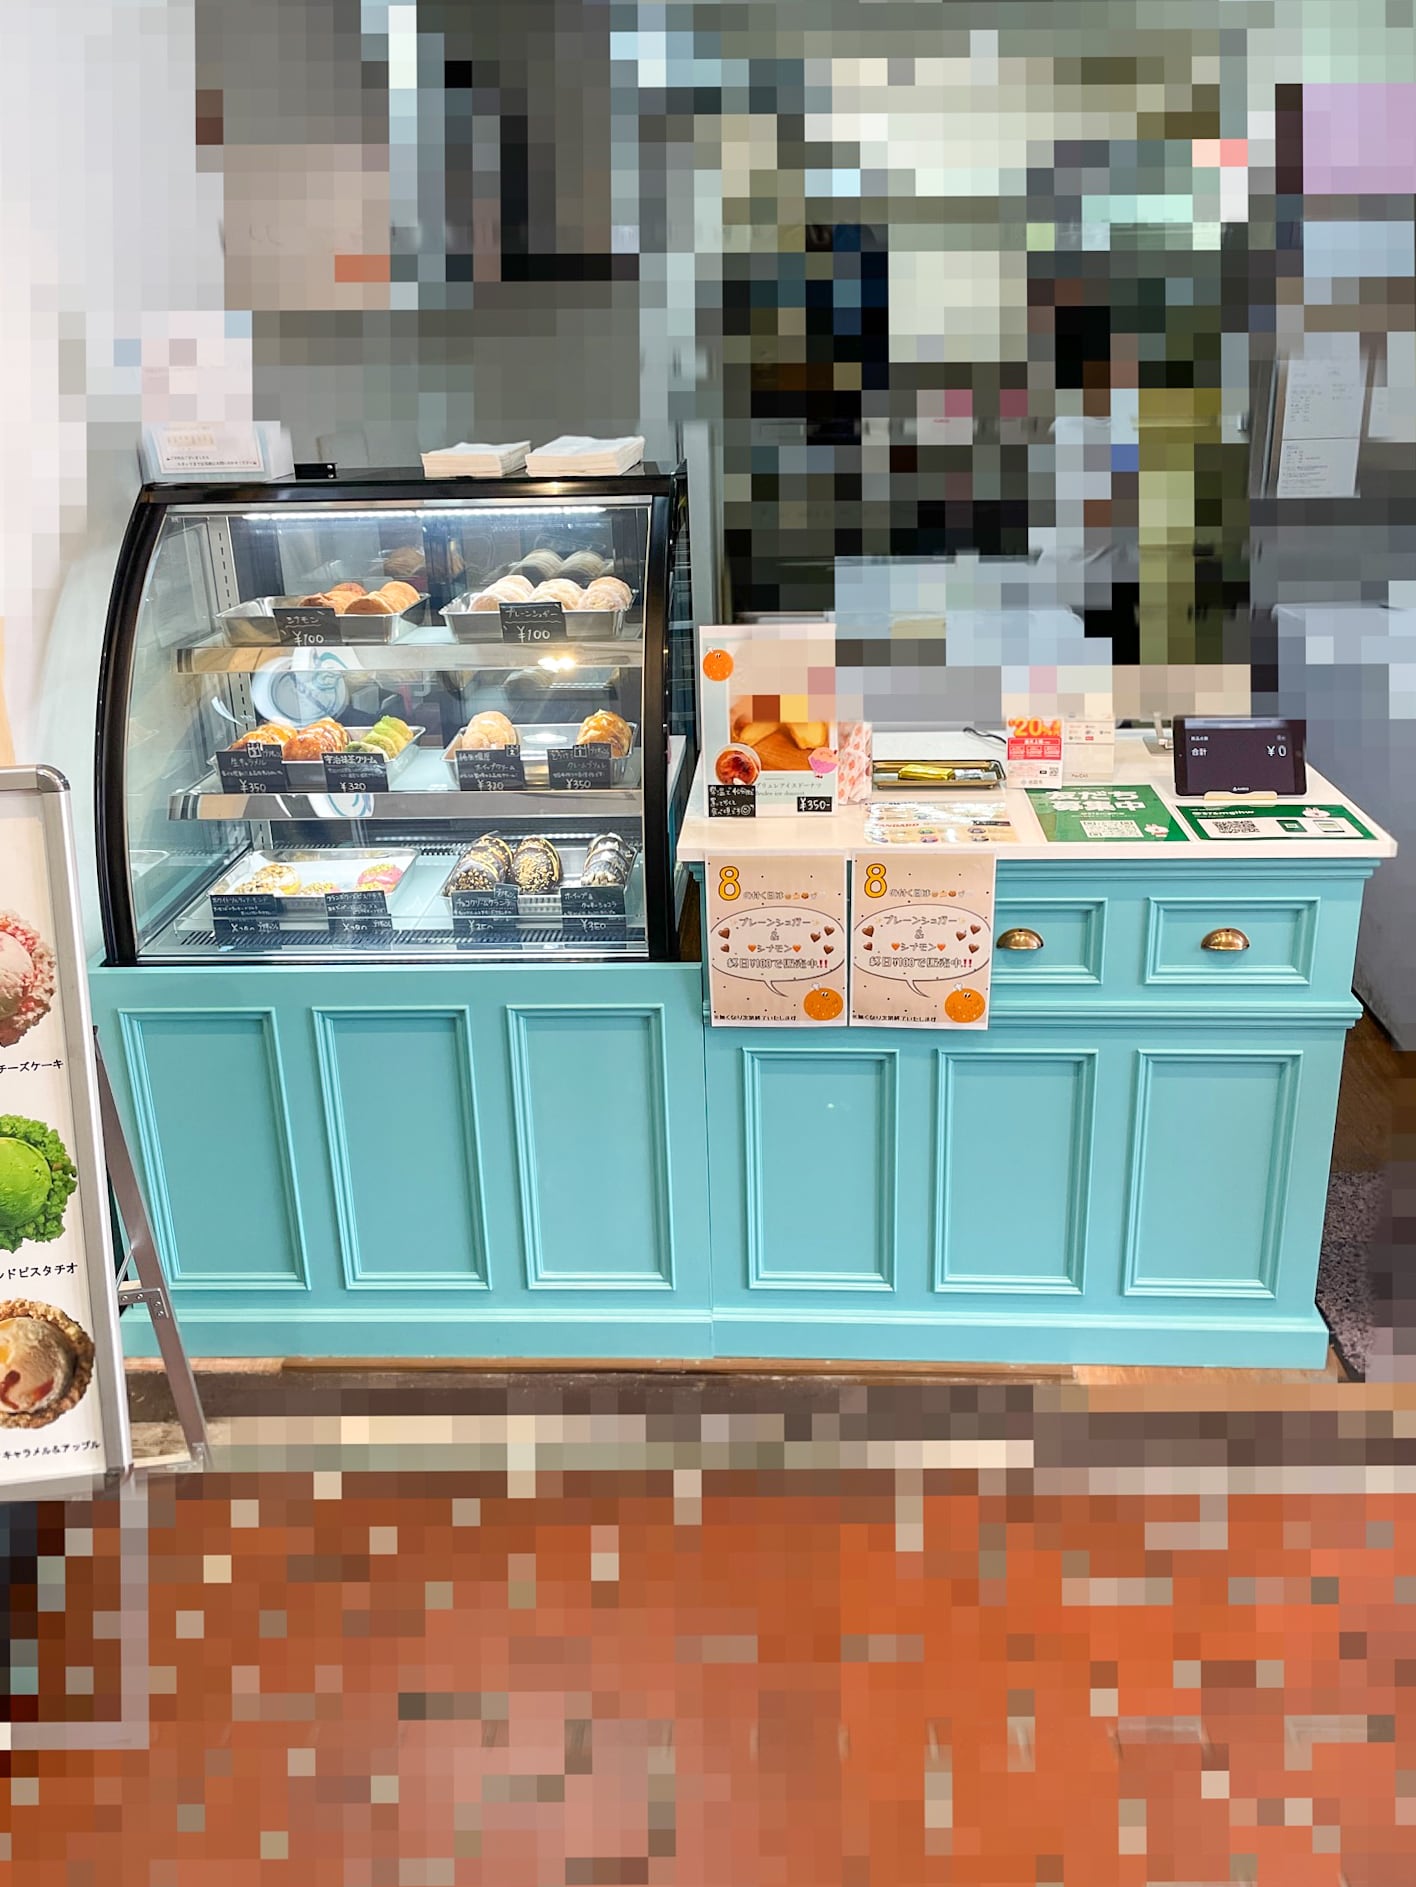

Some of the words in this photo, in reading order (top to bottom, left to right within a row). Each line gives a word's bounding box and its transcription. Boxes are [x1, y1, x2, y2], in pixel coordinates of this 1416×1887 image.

[291, 630, 325, 647] ¥100
[516, 625, 551, 644] ¥100
[1191, 747, 1208, 757] 合計
[239, 778, 267, 793] ¥350
[566, 778, 592, 791] ¥350
[1046, 790, 1139, 801] 友だち
[719, 866, 741, 901] 8
[864, 863, 888, 899] 8
[739, 918, 811, 927] プレーンシュガー
[884, 915, 957, 925] プレーンシュガー
[900, 942, 937, 952] シナモン
